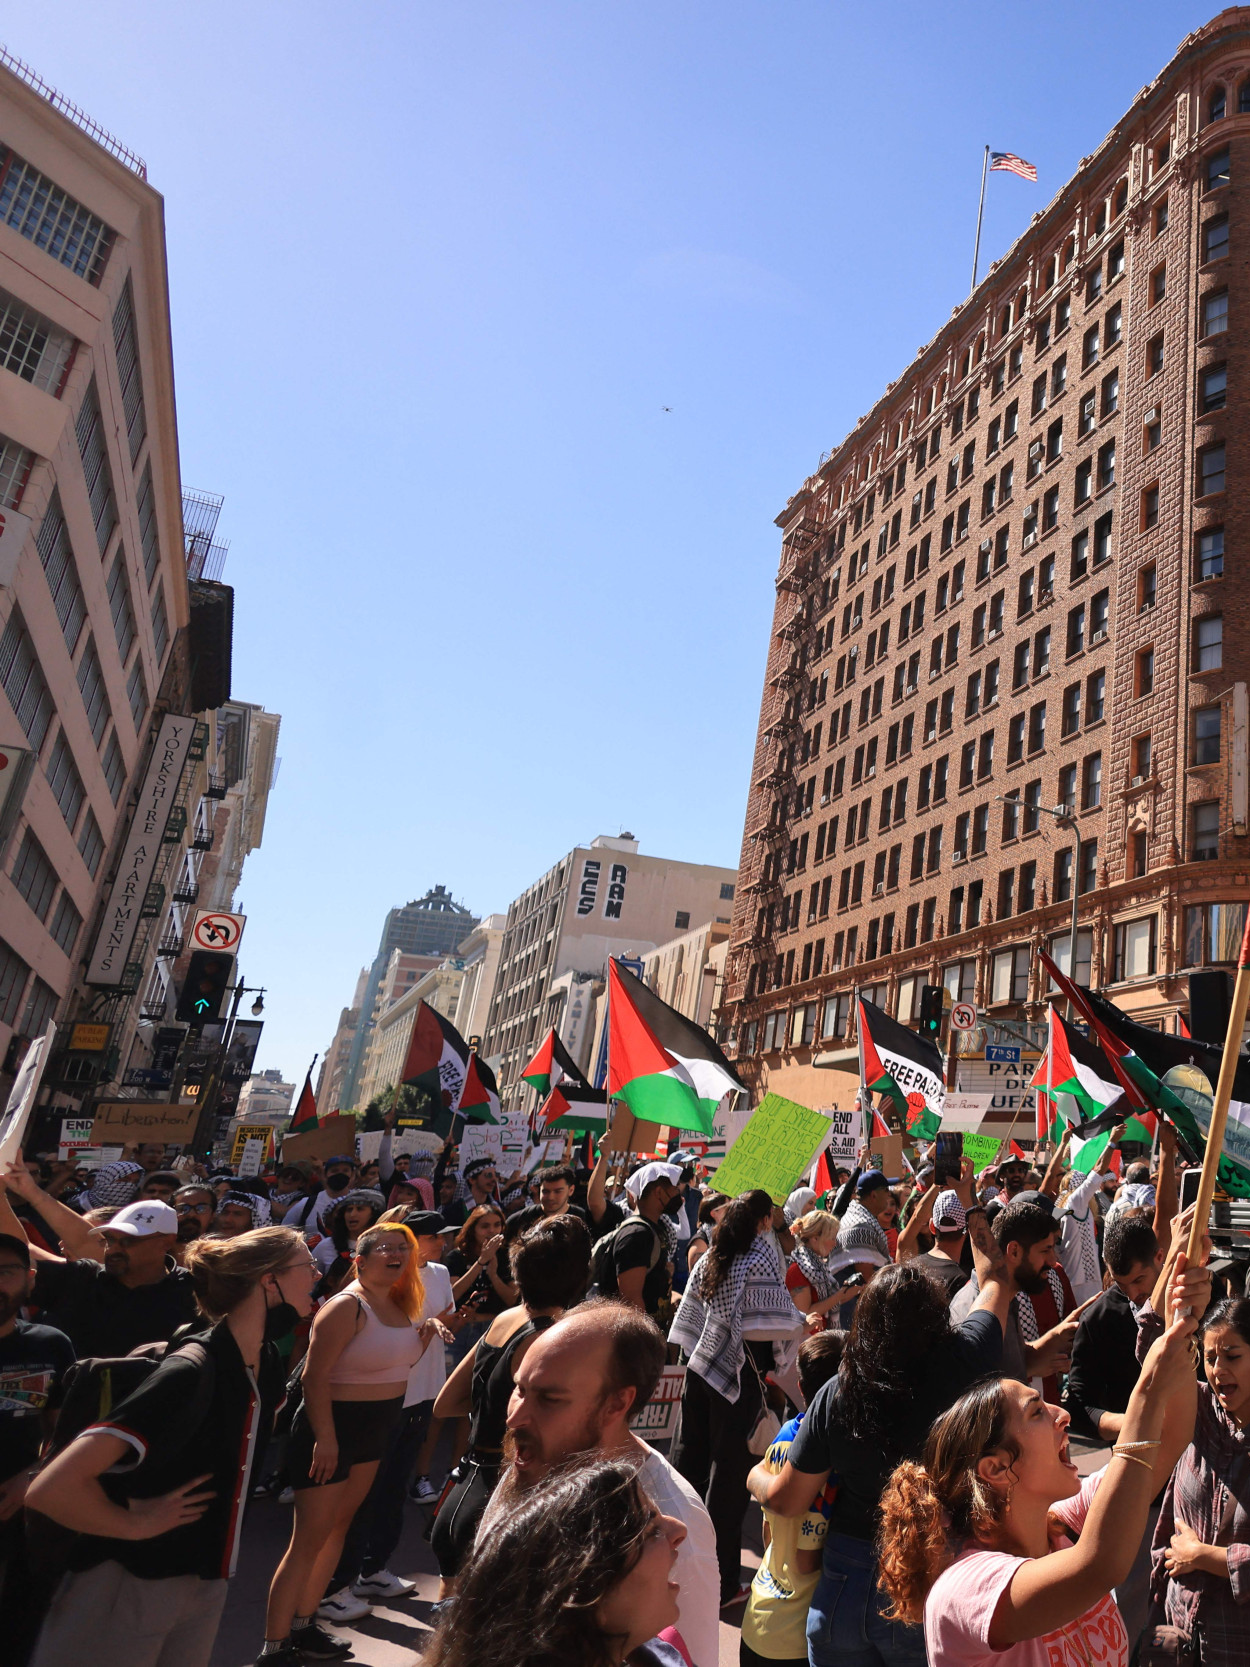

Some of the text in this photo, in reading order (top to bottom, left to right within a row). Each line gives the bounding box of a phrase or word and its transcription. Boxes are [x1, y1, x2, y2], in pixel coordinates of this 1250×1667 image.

[100, 727, 183, 972] YORKSHIRE APARTMENTS
[567, 990, 584, 1050] FAMILY
[990, 1048, 1016, 1060] 7th St
[162, 1070, 172, 1079] St
[103, 1109, 195, 1127] Liberation!
[832, 1112, 853, 1124] END
[66, 1120, 94, 1130] END
[832, 1123, 850, 1134] ALL
[237, 1133, 249, 1144] IS
[841, 1137, 856, 1147] AID
[963, 1150, 990, 1160] HILDREN
